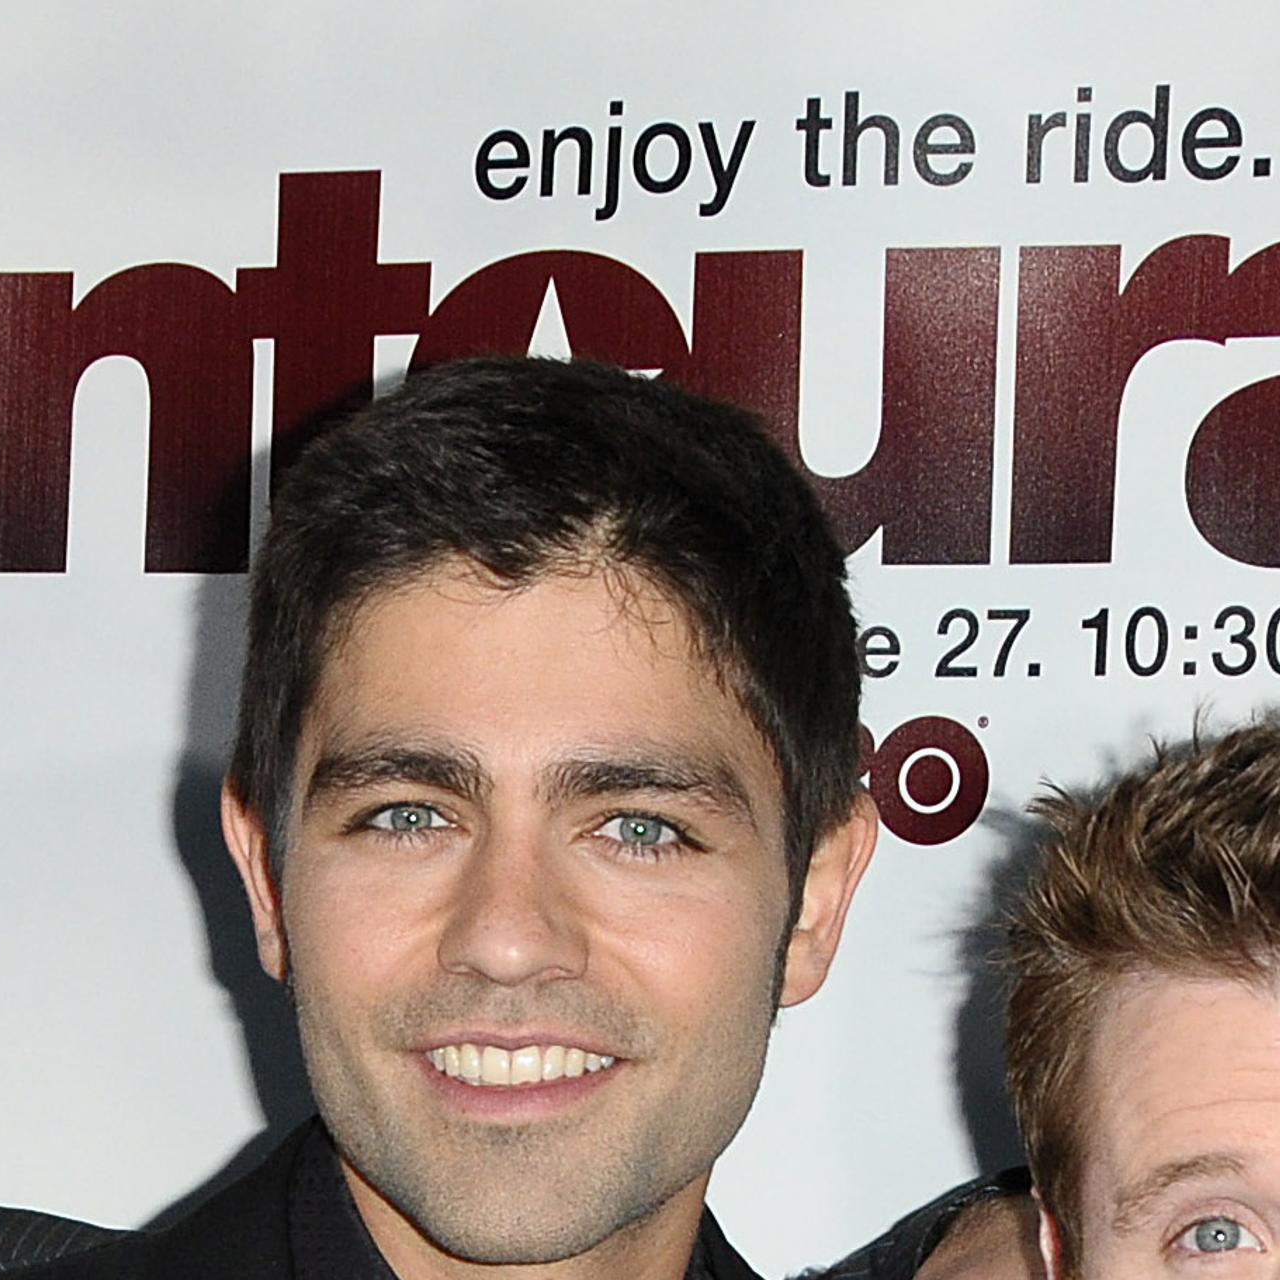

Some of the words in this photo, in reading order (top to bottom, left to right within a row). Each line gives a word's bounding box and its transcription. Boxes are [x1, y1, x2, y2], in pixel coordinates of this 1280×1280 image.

[474, 100, 757, 221] enjoy
[795, 90, 977, 188] the
[1025, 84, 1272, 184] ride.
[934, 608, 1041, 678] 27.
